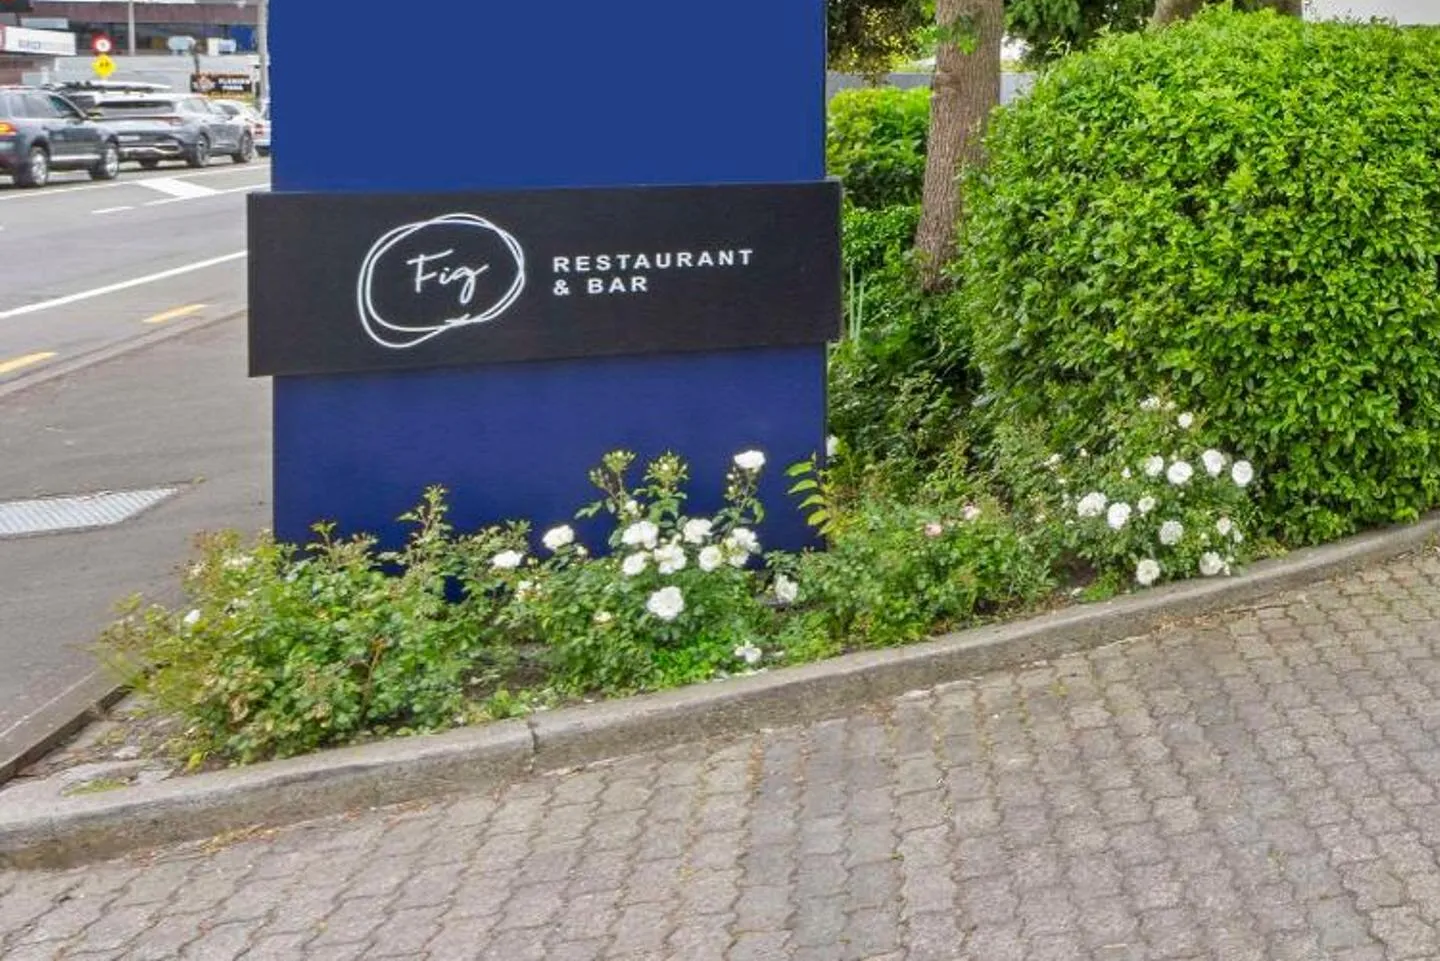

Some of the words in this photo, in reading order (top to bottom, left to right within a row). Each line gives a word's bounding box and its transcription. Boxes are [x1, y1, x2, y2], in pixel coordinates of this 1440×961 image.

[553, 250, 753, 273] RESTAURANT
[407, 249, 488, 304] Fig
[553, 279, 570, 296] &
[588, 276, 648, 294] BAR
